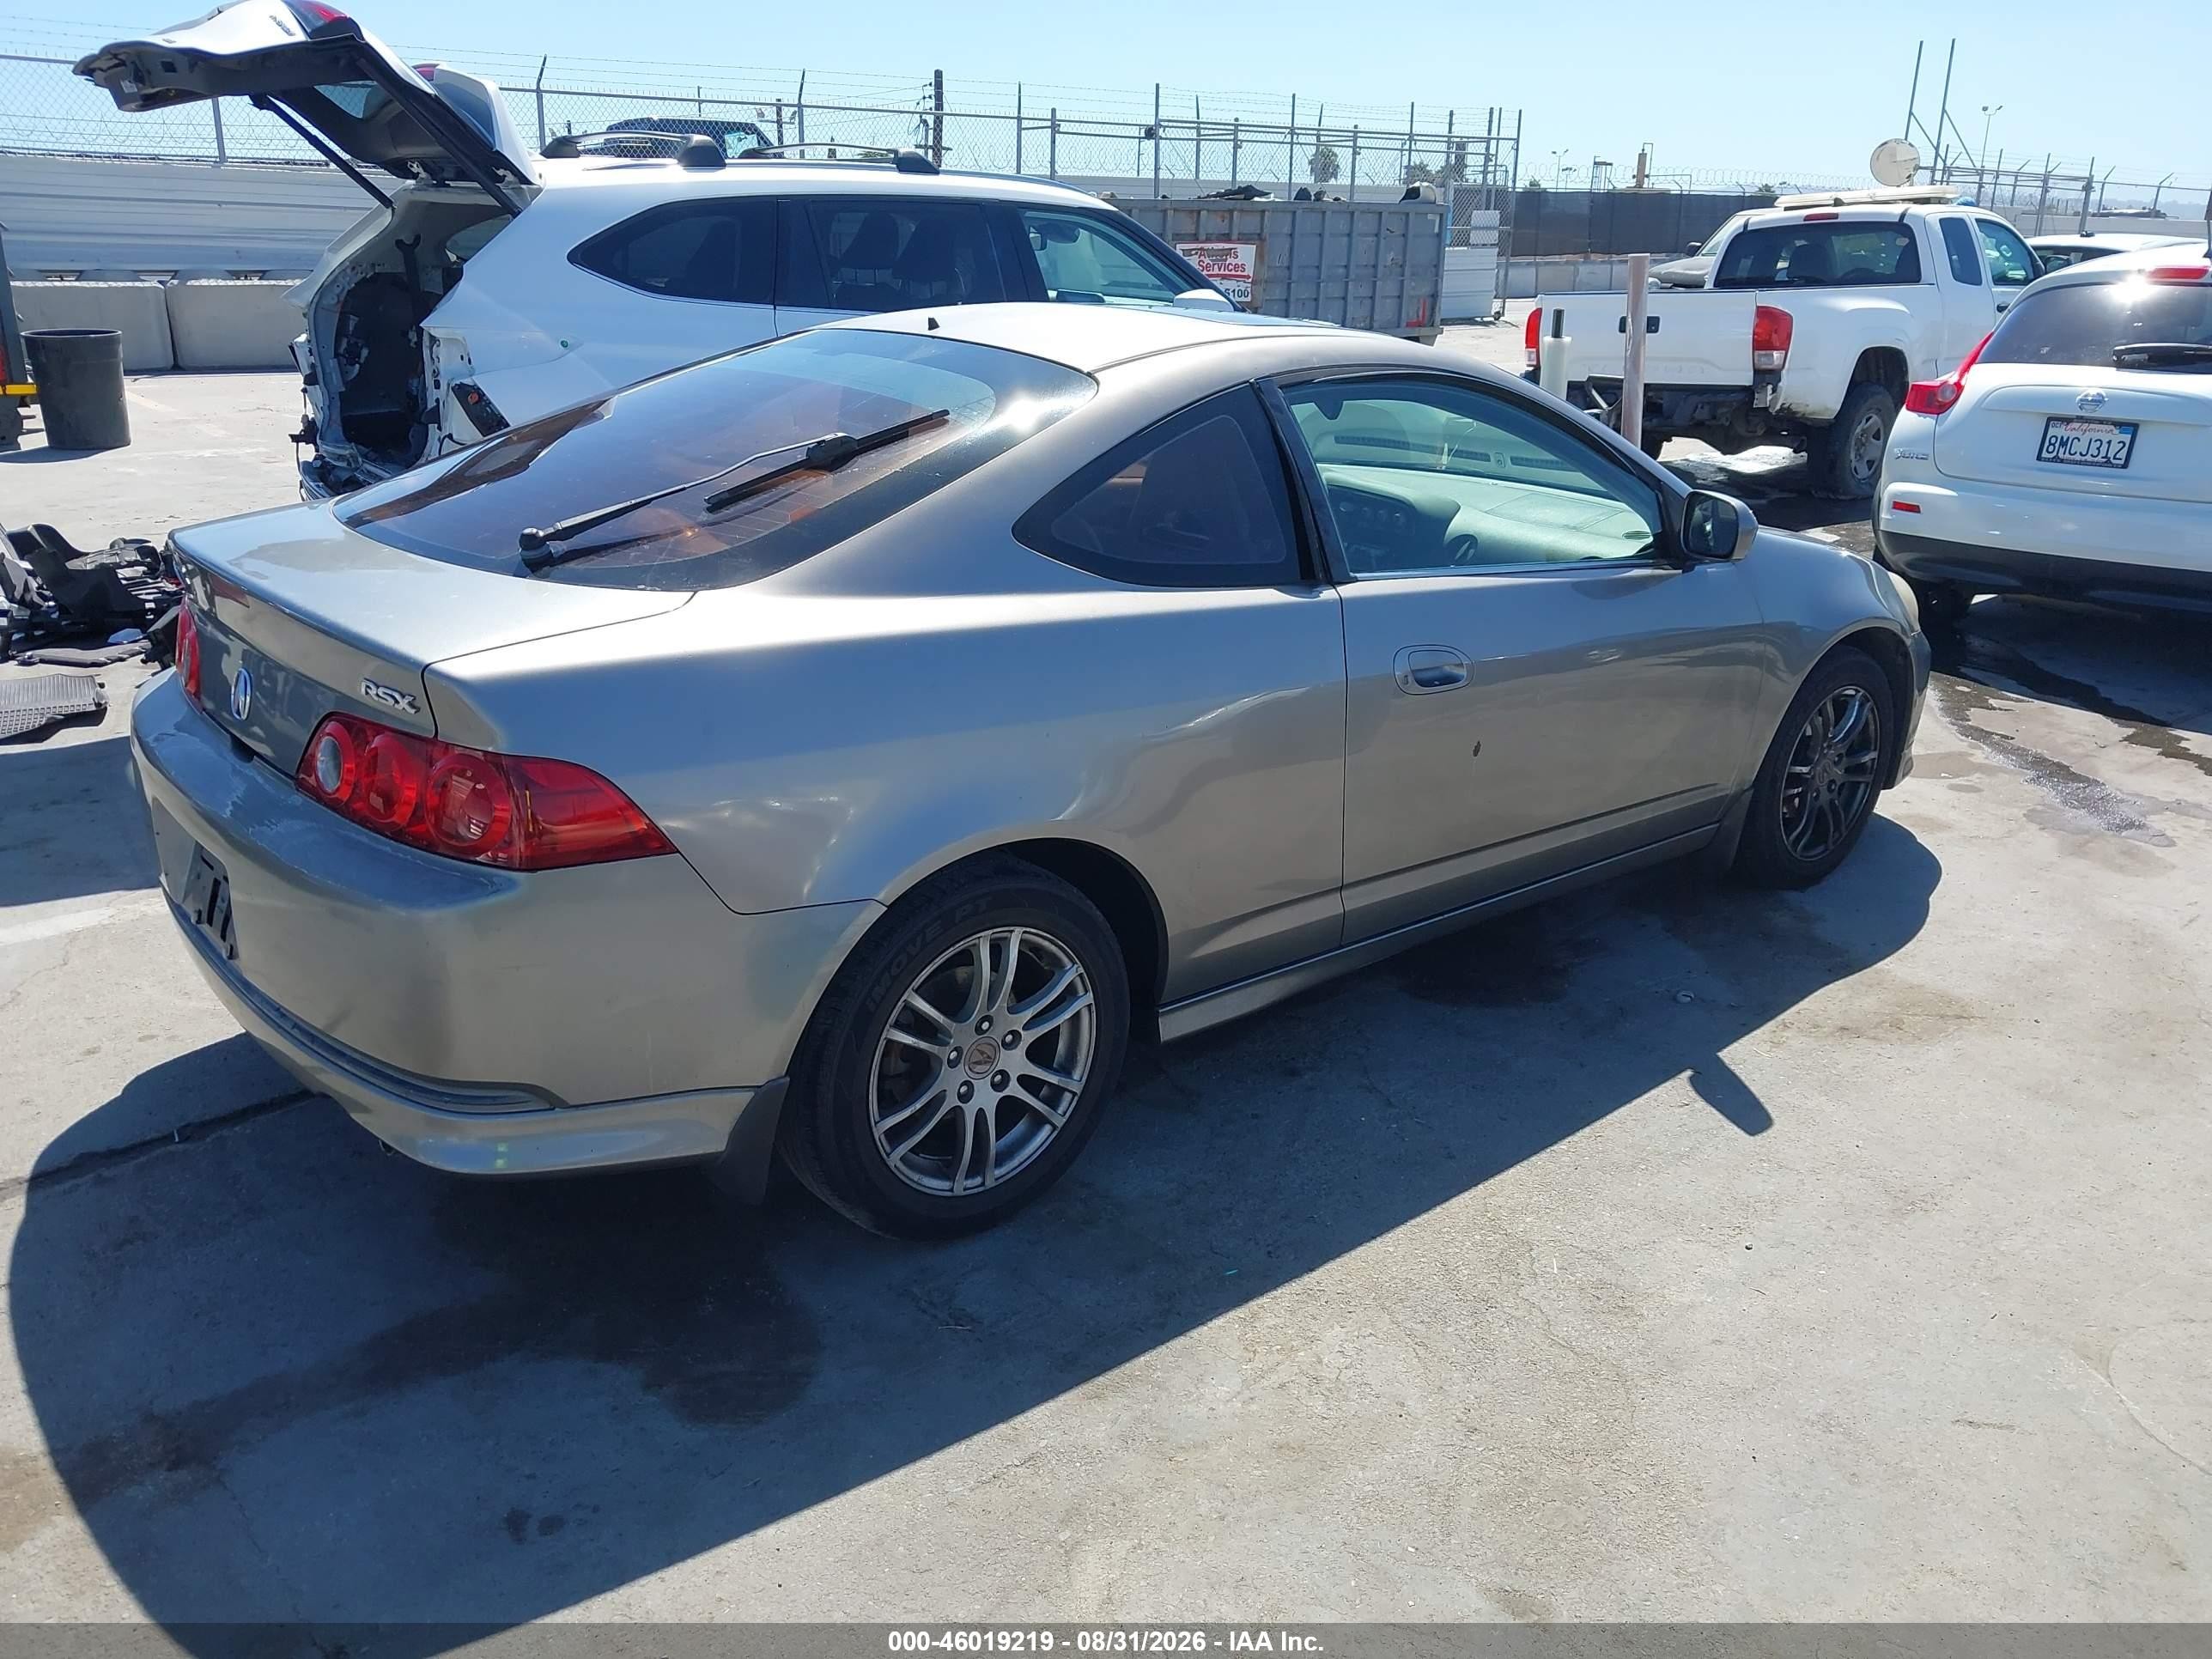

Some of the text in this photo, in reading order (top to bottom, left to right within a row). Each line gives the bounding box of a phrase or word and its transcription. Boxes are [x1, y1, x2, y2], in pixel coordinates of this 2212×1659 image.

[1197, 260, 1247, 272] Services
[2045, 434, 2126, 460] 8MCJ312
[361, 678, 419, 714] RSX
